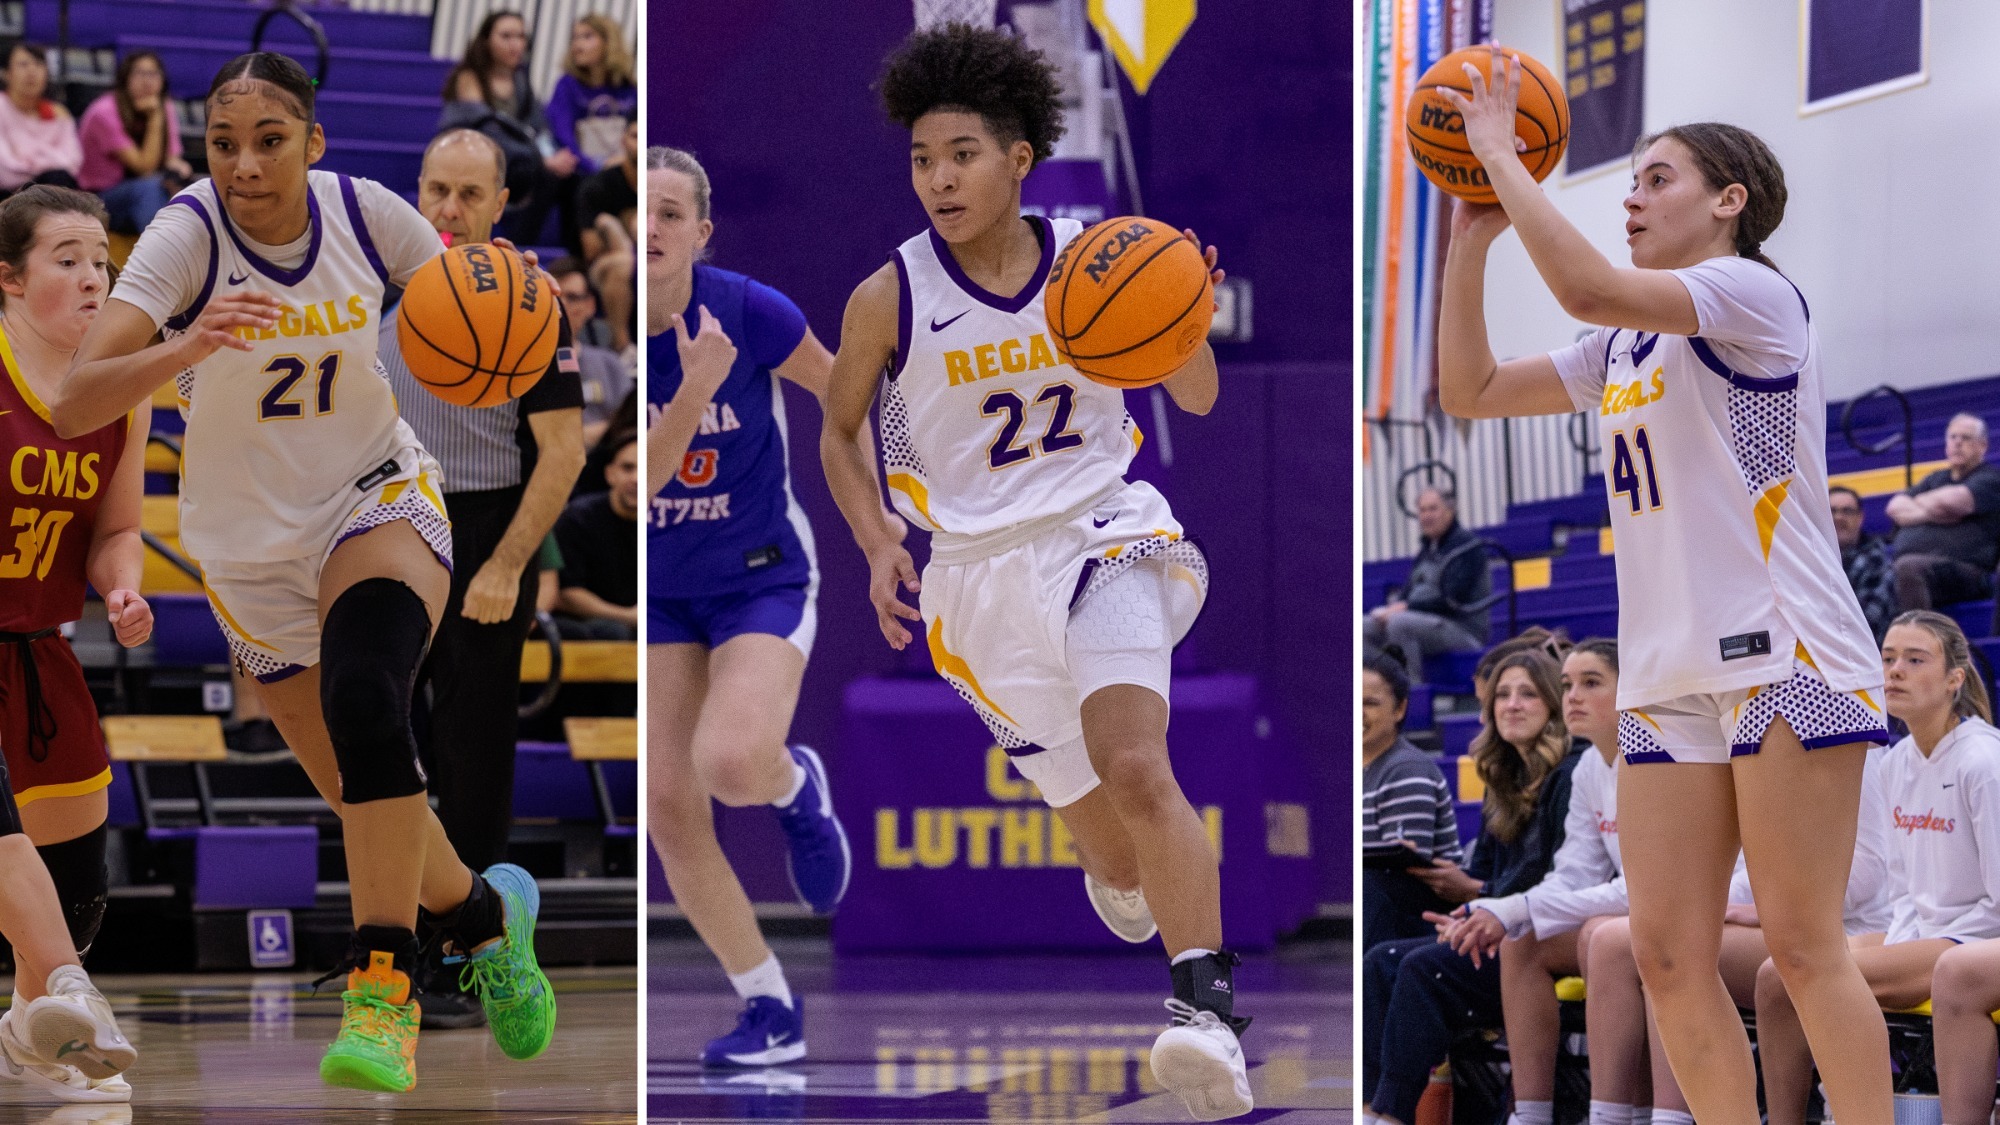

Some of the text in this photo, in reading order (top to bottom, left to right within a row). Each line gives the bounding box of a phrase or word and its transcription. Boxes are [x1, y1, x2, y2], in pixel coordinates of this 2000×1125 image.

[1420, 102, 1467, 133] CAA
[462, 244, 499, 293] NCAA
[1083, 223, 1153, 284] NCAA
[235, 294, 368, 341] GALS
[257, 350, 343, 423] 21
[943, 333, 1067, 387] REGA
[1601, 366, 1665, 416] EGALS
[978, 380, 1086, 473] 22
[10, 446, 100, 500] CMS
[1610, 424, 1664, 517] 41
[0, 507, 74, 582] 30
[876, 806, 1222, 868] LUTHE
